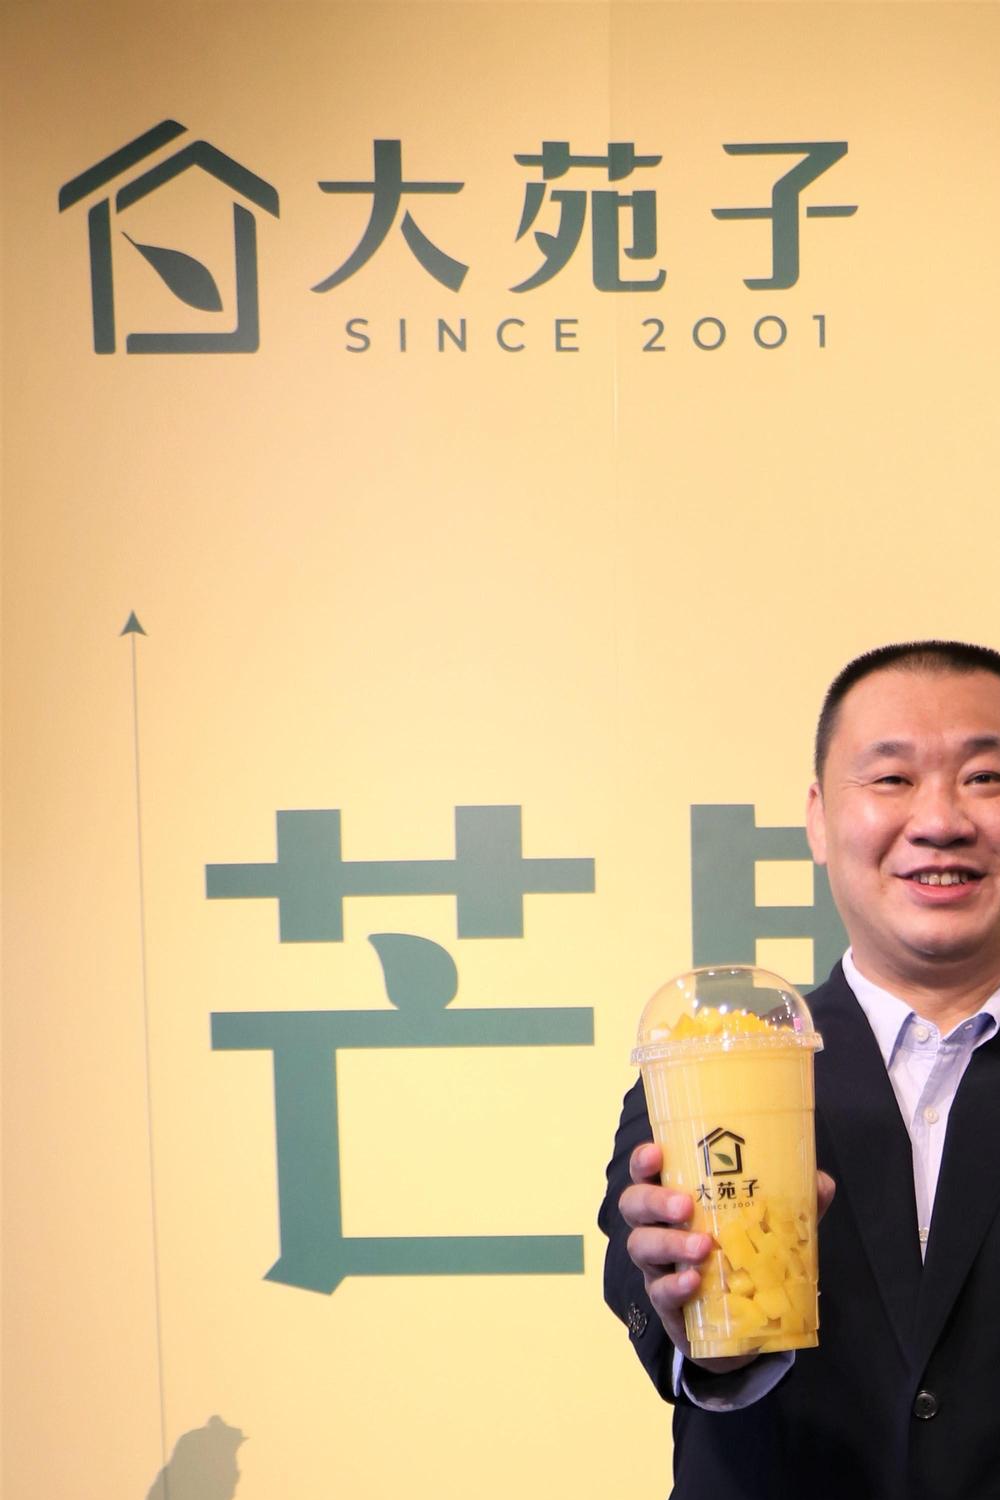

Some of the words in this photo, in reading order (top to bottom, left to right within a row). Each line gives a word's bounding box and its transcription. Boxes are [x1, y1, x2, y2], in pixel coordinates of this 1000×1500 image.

[310, 139, 860, 294] 大苑子
[346, 317, 583, 354] SINCE
[641, 314, 829, 352] 2001
[205, 803, 849, 1296] 芒
[696, 1179, 760, 1202] 大苑子
